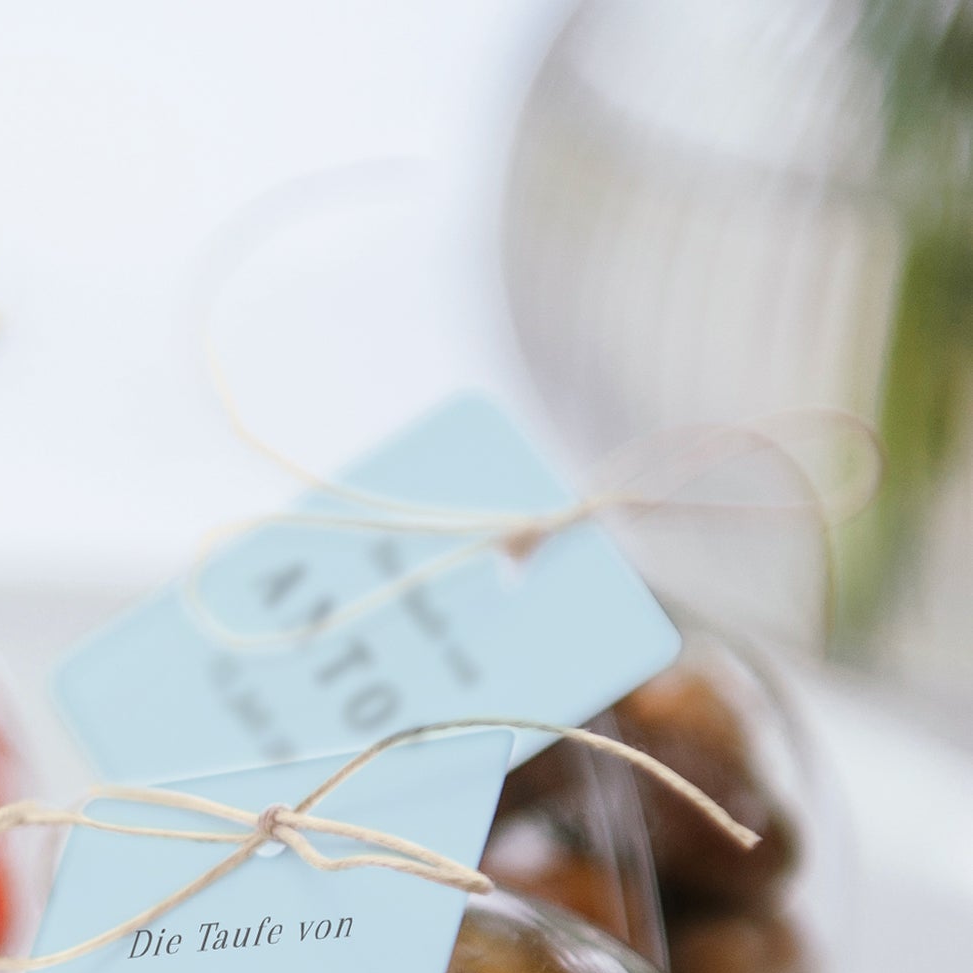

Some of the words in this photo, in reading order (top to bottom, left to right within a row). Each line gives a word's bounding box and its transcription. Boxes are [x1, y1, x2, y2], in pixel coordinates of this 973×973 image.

[128, 929, 182, 959] Die
[197, 916, 283, 952] Taufe
[299, 916, 354, 942] von
